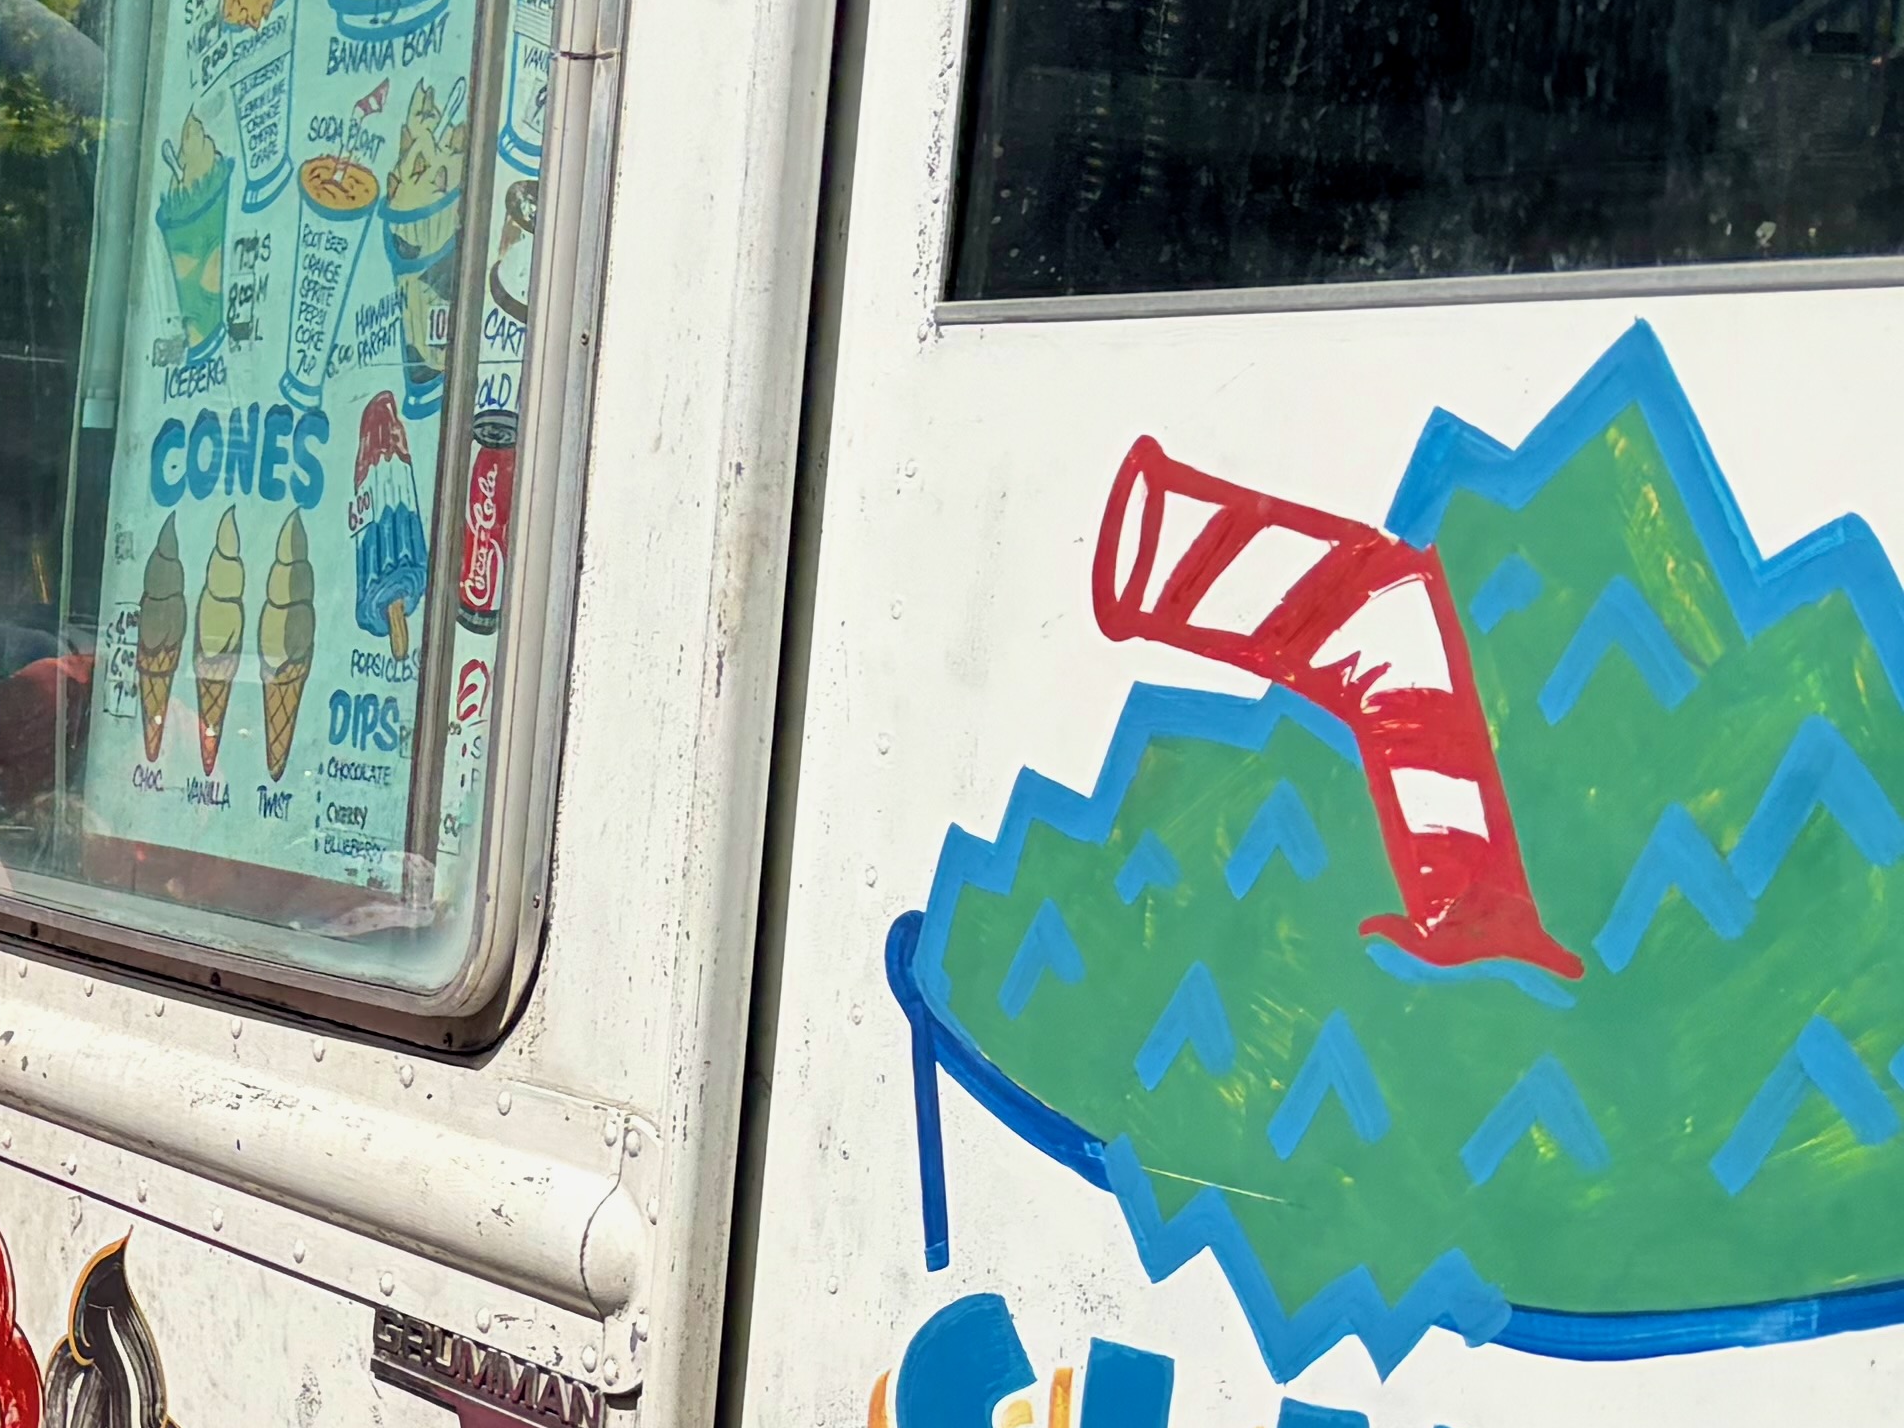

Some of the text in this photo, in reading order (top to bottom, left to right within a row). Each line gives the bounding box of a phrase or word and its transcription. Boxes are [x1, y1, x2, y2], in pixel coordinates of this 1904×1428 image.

[327, 11, 451, 76] BANANA BOAT
[308, 115, 343, 144] SODA
[295, 325, 325, 351] COKE
[163, 355, 228, 404] ICEBERG
[476, 374, 512, 410] OLD
[150, 401, 330, 510] CONES
[459, 463, 499, 607] Coca-Cola
[328, 689, 400, 752] DIPS
[327, 756, 391, 787] CHOCOLATE
[186, 776, 231, 812] VANILLA
[326, 801, 369, 830] CHERRY
